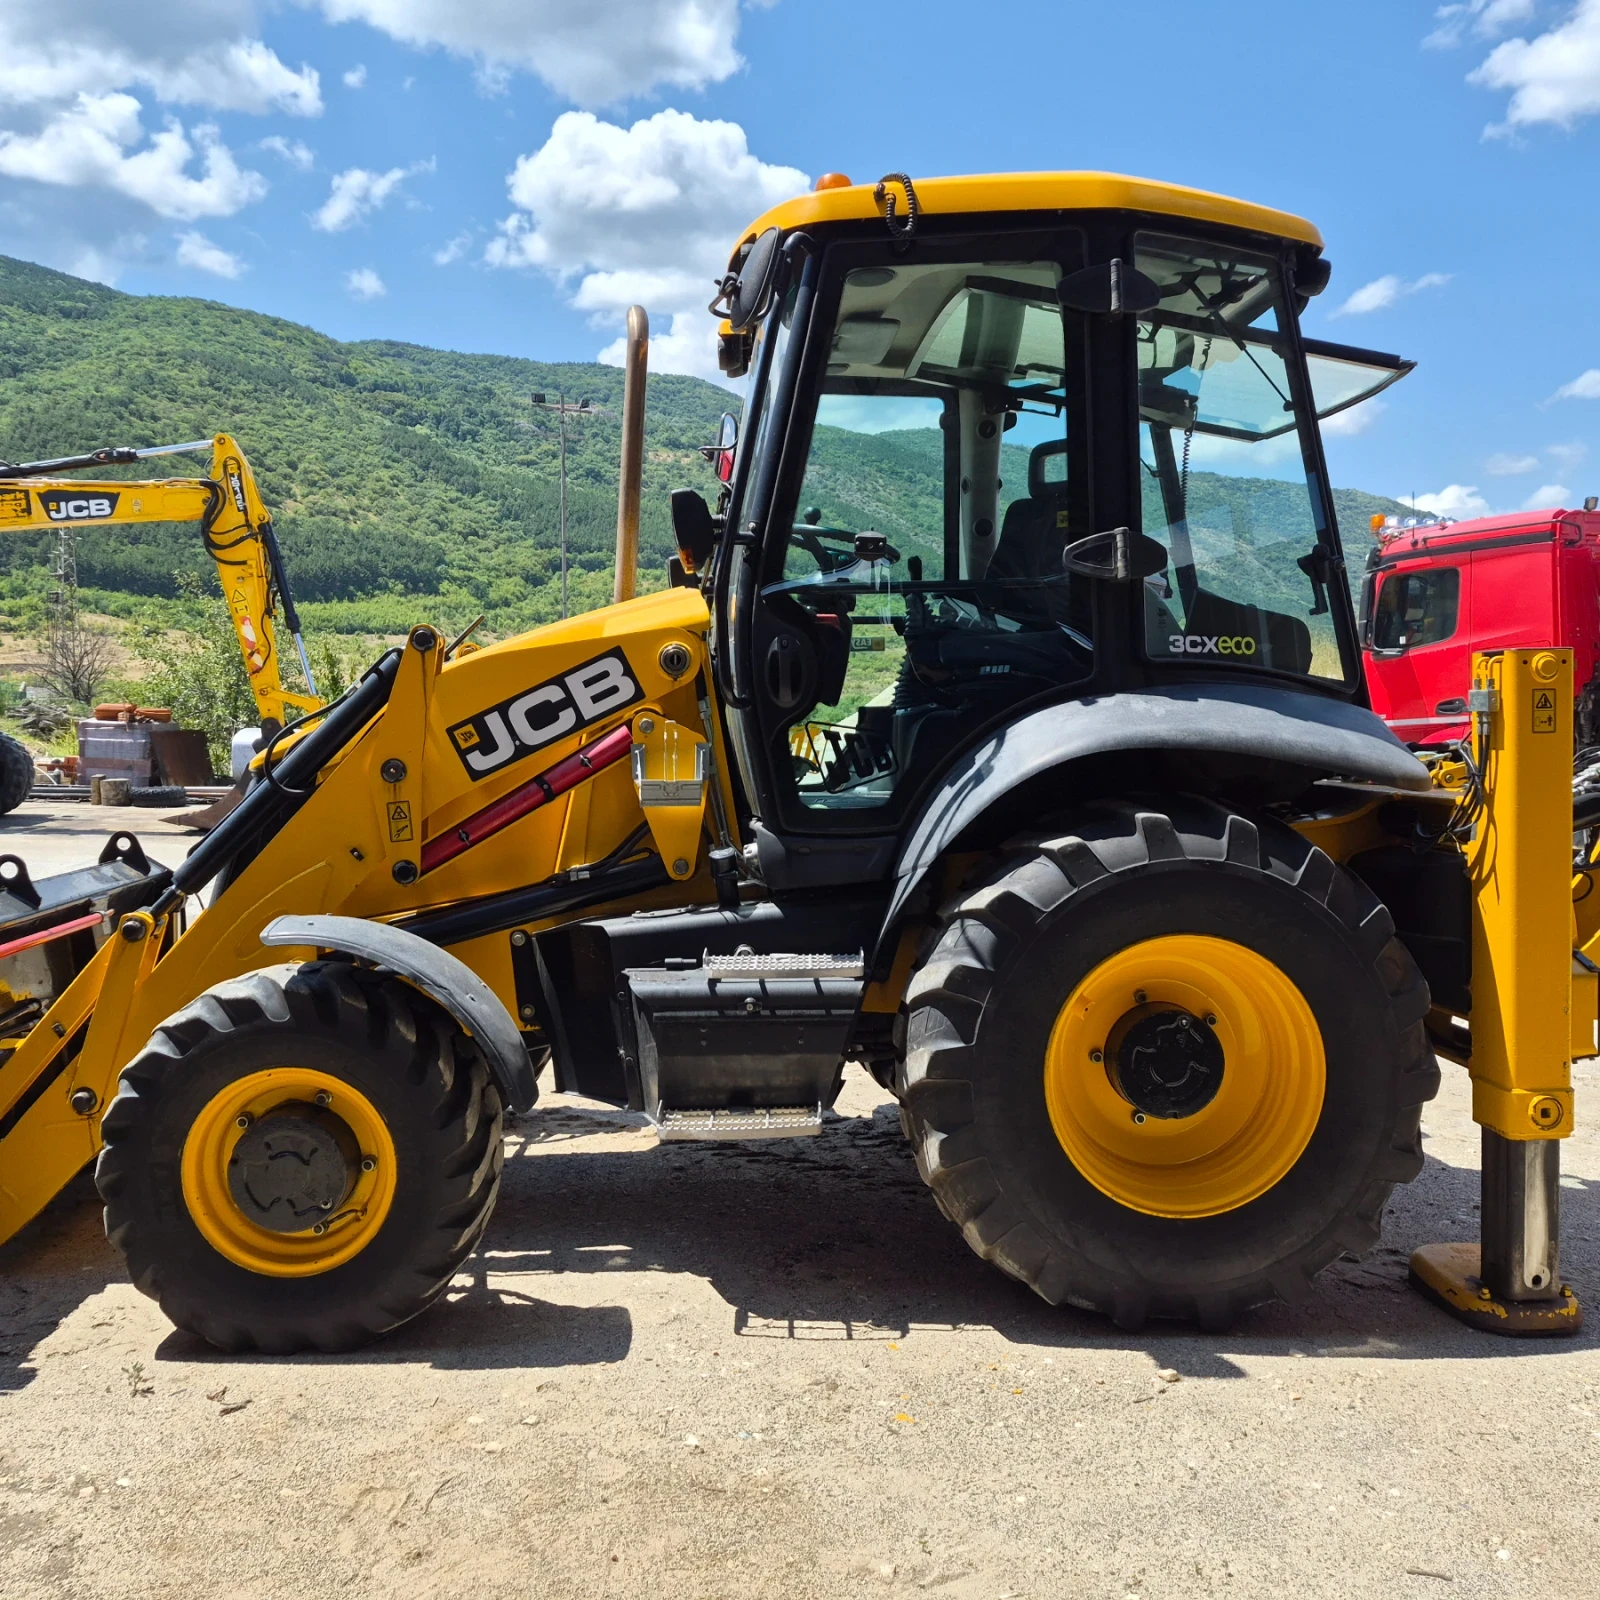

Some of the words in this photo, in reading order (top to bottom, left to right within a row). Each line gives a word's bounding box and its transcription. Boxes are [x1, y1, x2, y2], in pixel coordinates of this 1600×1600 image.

[49, 498, 111, 519] JCB
[1169, 635, 1256, 655] 3CXeco
[466, 657, 636, 771] JCB
